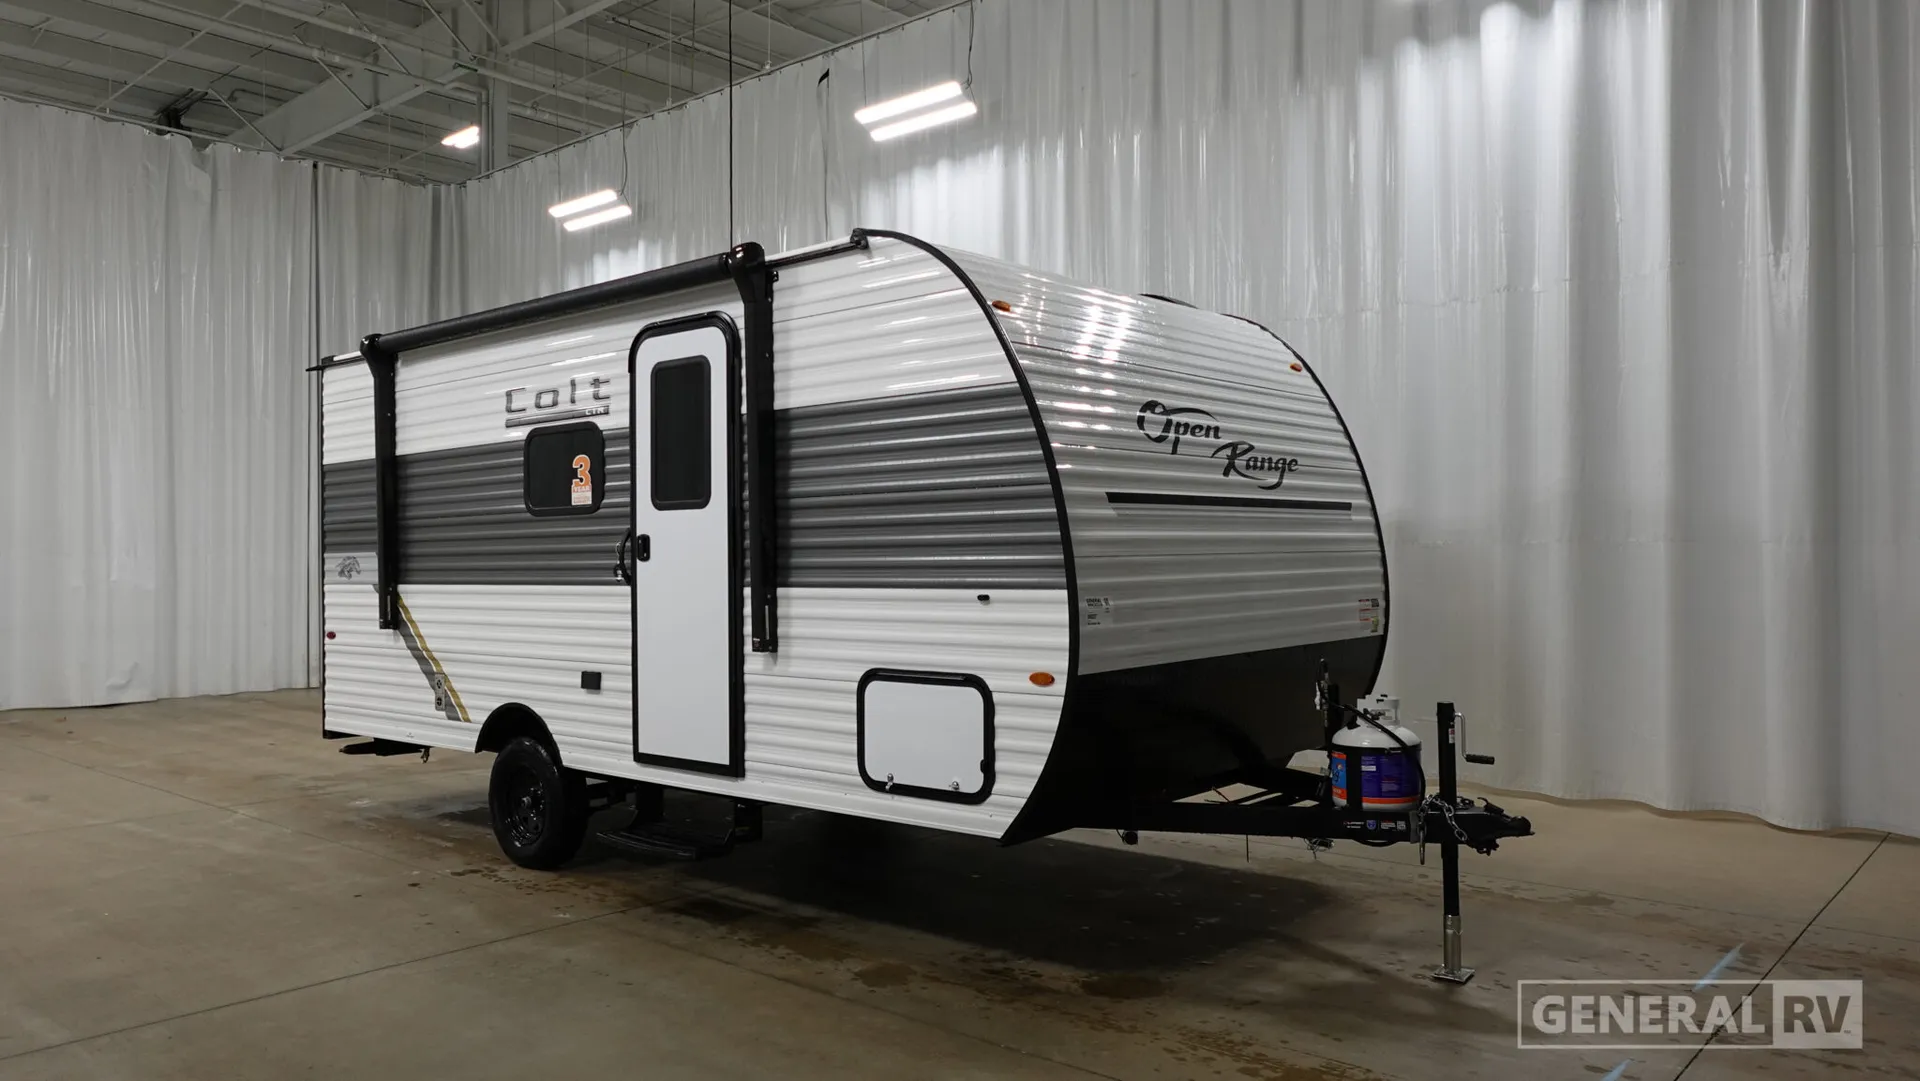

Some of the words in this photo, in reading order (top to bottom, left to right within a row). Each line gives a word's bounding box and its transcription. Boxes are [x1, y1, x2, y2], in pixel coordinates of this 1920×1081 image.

[505, 378, 610, 413] Colt
[1136, 400, 1222, 455] Open
[572, 454, 591, 486] 3
[1211, 440, 1299, 490] Range
